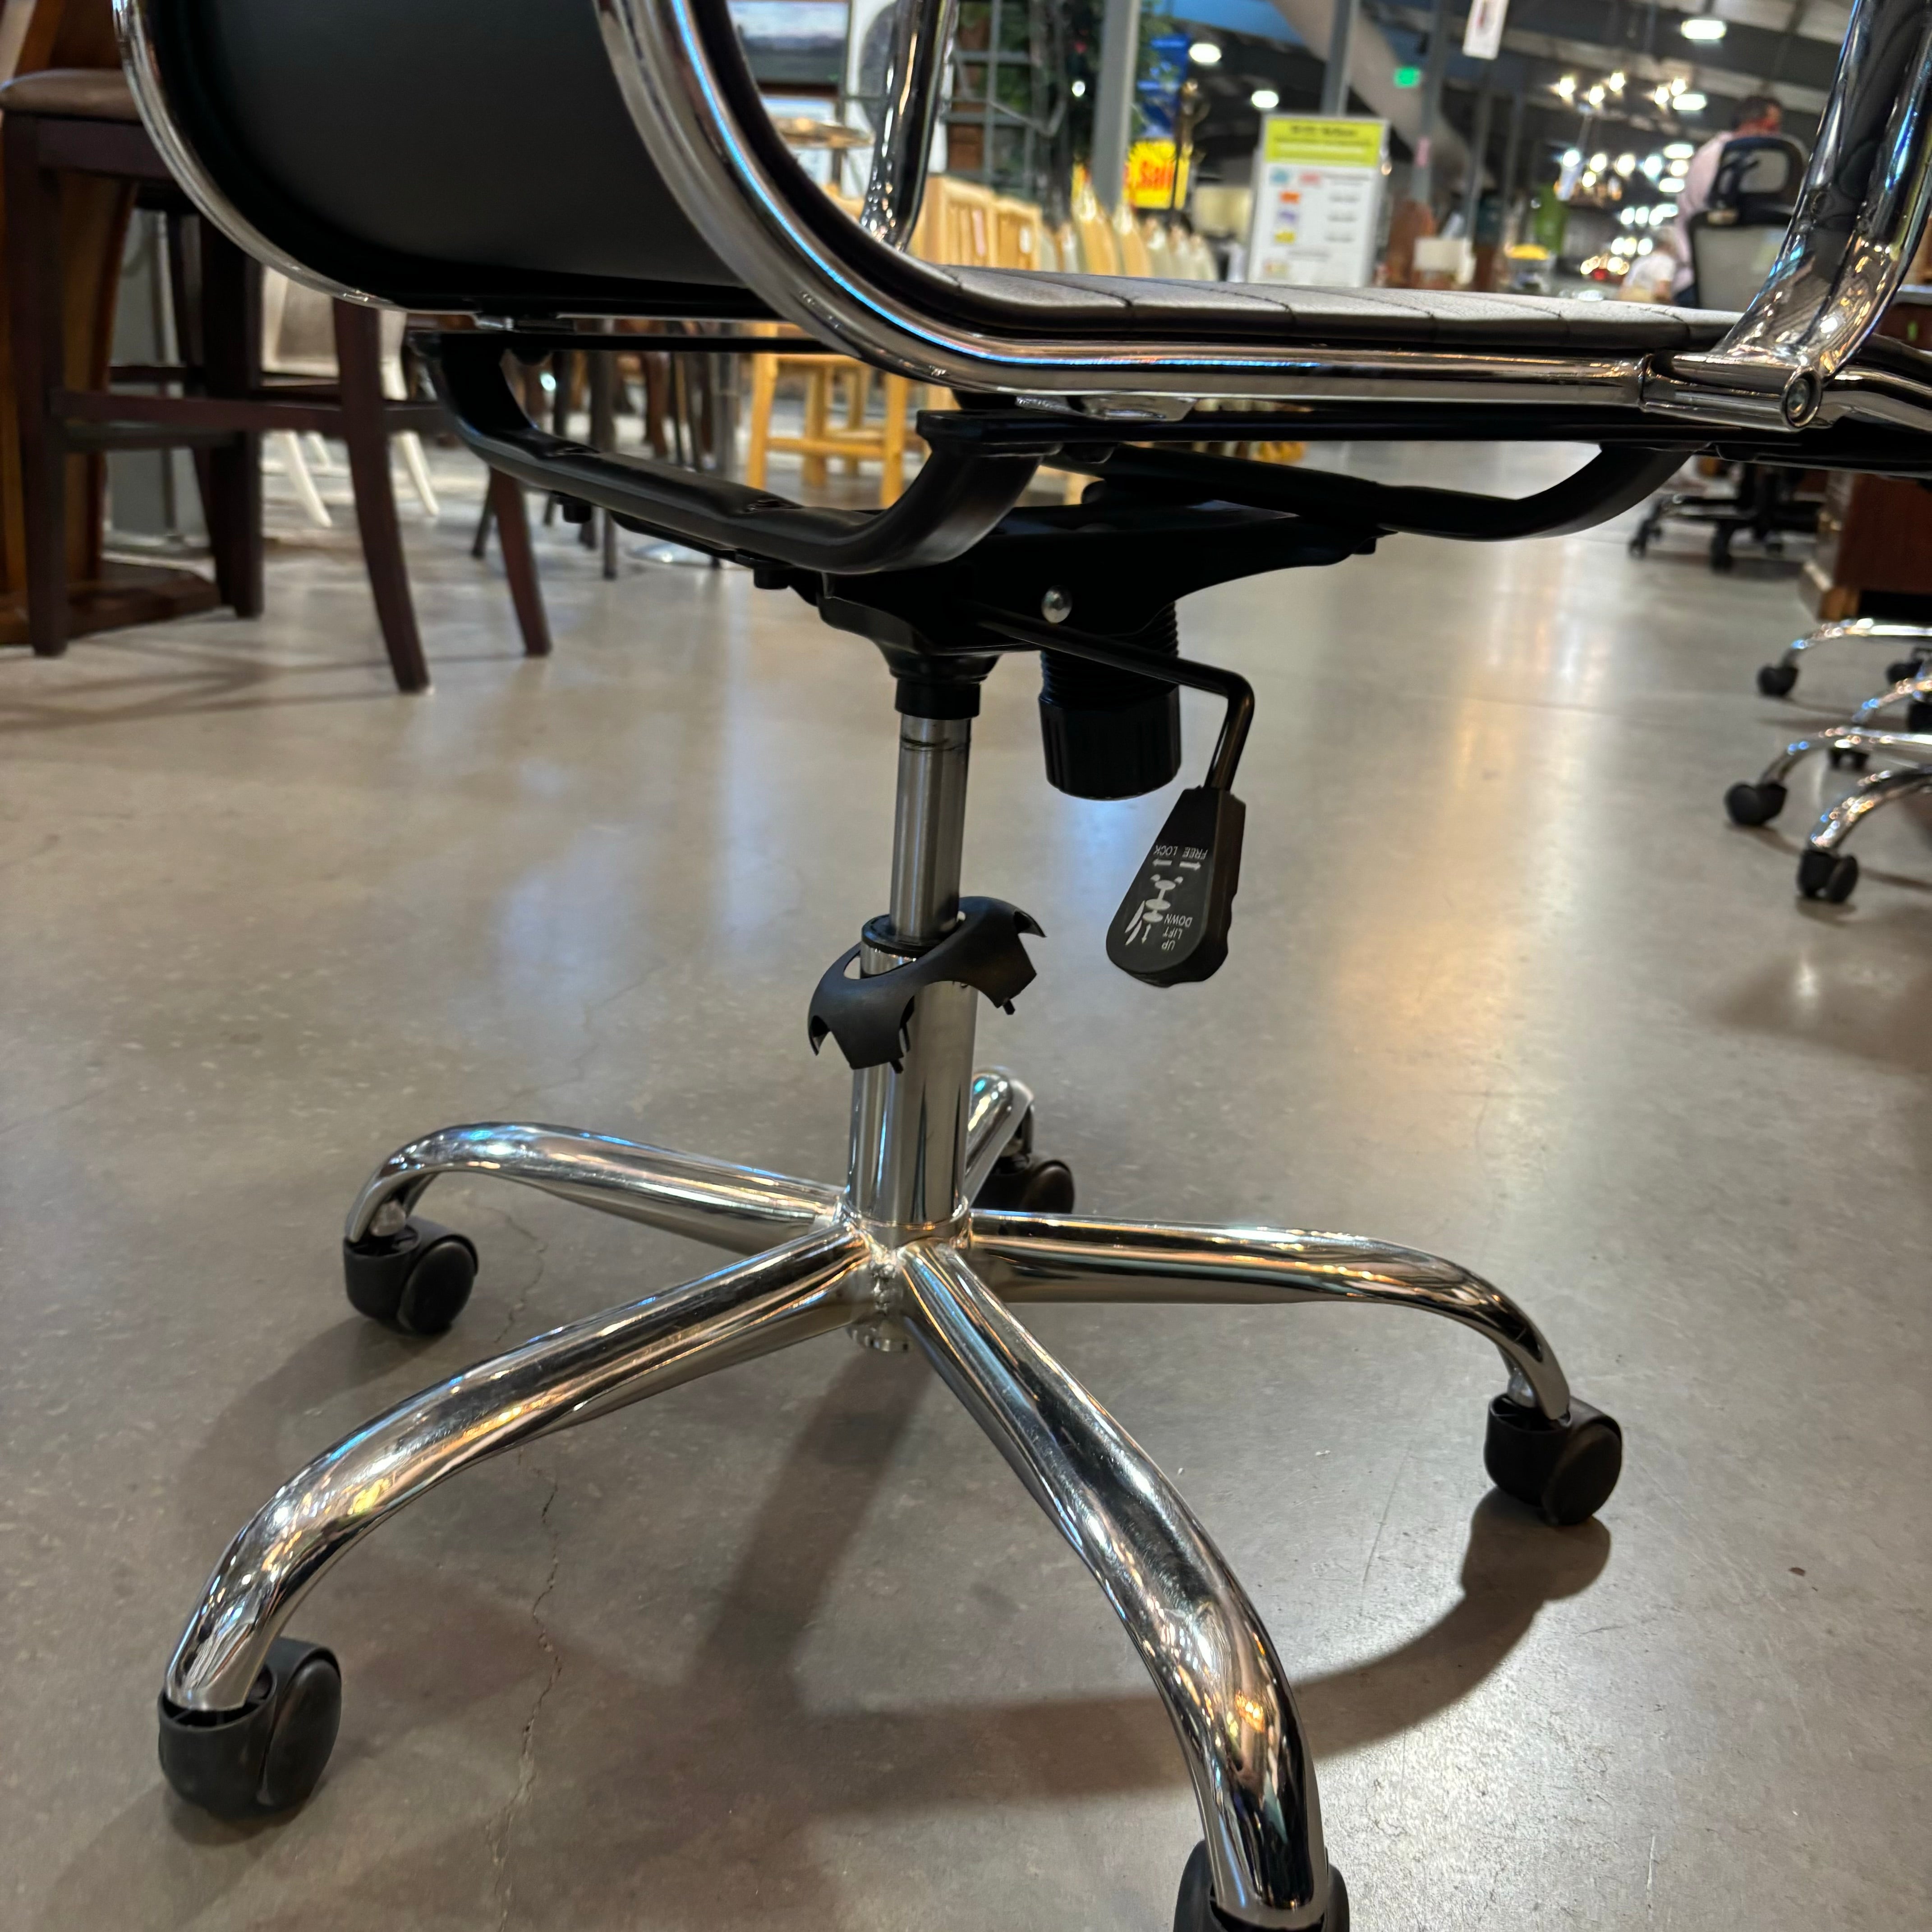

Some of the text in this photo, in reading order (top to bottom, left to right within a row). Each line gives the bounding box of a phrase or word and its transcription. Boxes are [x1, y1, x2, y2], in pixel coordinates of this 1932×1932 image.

[1154, 845, 1208, 860] FREE LOCK
[1164, 913, 1193, 928] DOWN
[1162, 926, 1182, 940] LIFT
[1161, 939, 1175, 951] UP
